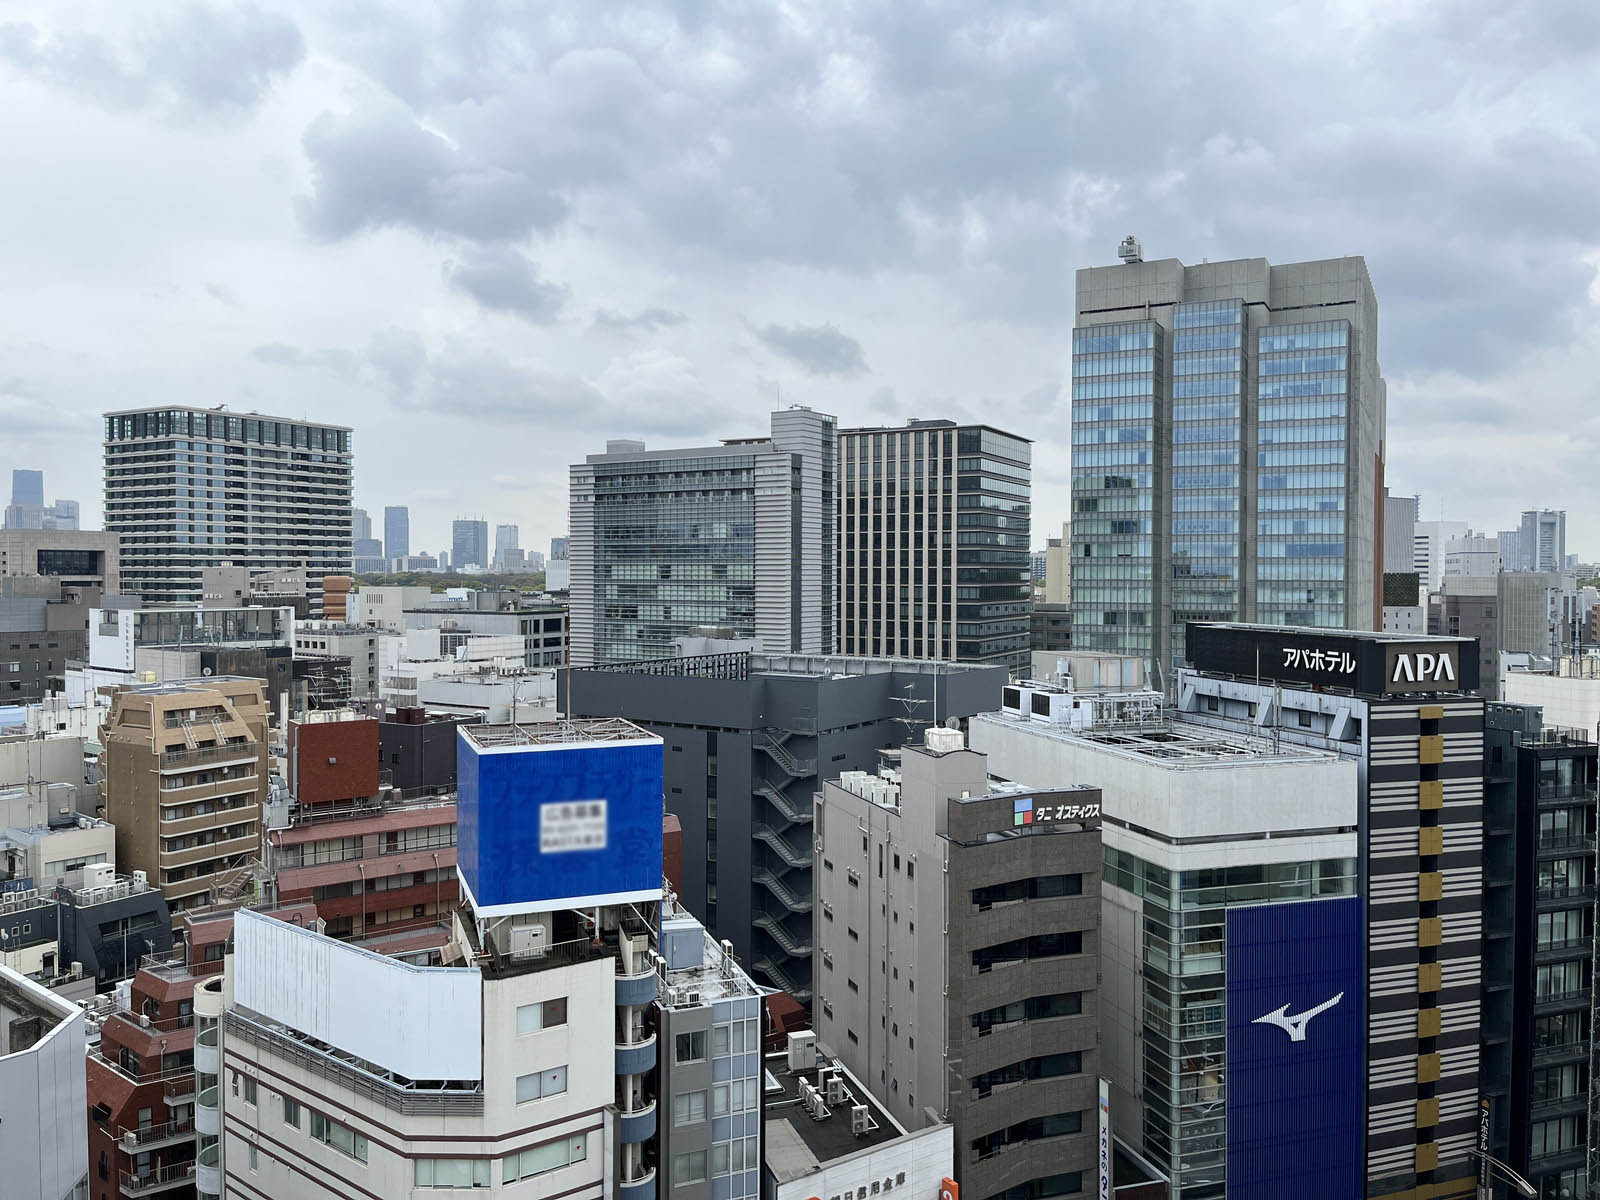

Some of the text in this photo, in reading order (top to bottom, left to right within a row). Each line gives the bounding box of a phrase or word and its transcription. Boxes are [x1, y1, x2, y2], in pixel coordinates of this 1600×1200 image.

[1282, 648, 1356, 674] アパホテル
[1392, 653, 1455, 682] APA
[1480, 1109, 1489, 1151] アパホテル
